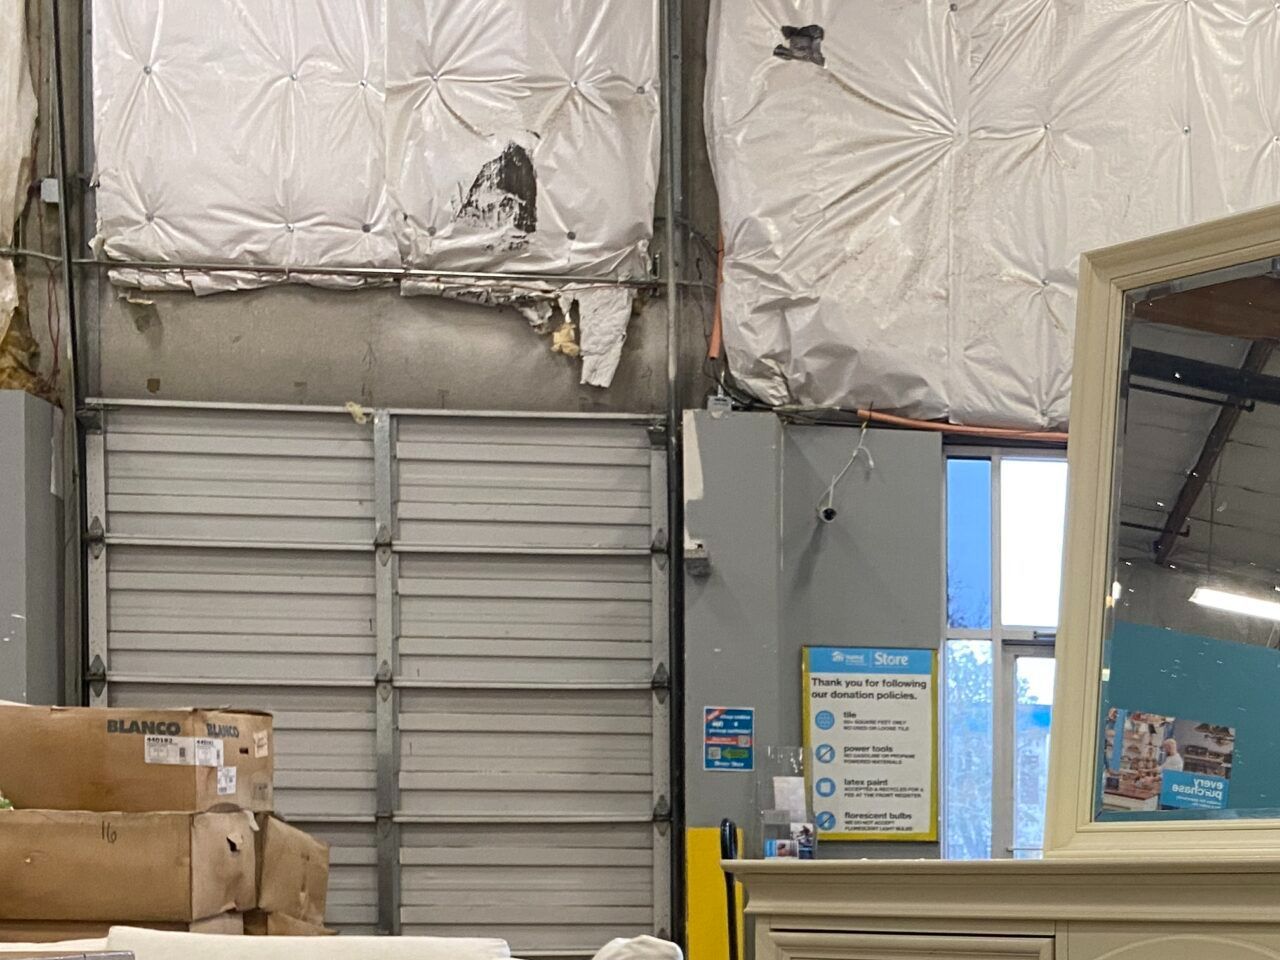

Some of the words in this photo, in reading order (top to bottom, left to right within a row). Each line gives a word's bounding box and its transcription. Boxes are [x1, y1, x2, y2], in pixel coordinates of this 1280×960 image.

[874, 651, 909, 666] Store
[811, 677, 842, 687] Thank
[845, 679, 863, 689] you
[865, 679, 880, 688] for
[882, 679, 927, 689] following
[830, 690, 874, 700] donation
[876, 691, 917, 700] policies.
[843, 711, 857, 719] tile
[106, 719, 182, 735] BLANCO
[206, 723, 240, 738] BLANCO
[843, 746, 870, 754] power
[844, 778, 865, 786] latex
[867, 778, 888, 788] paint
[844, 812, 888, 820] florescent
[101, 820, 117, 844] 16
